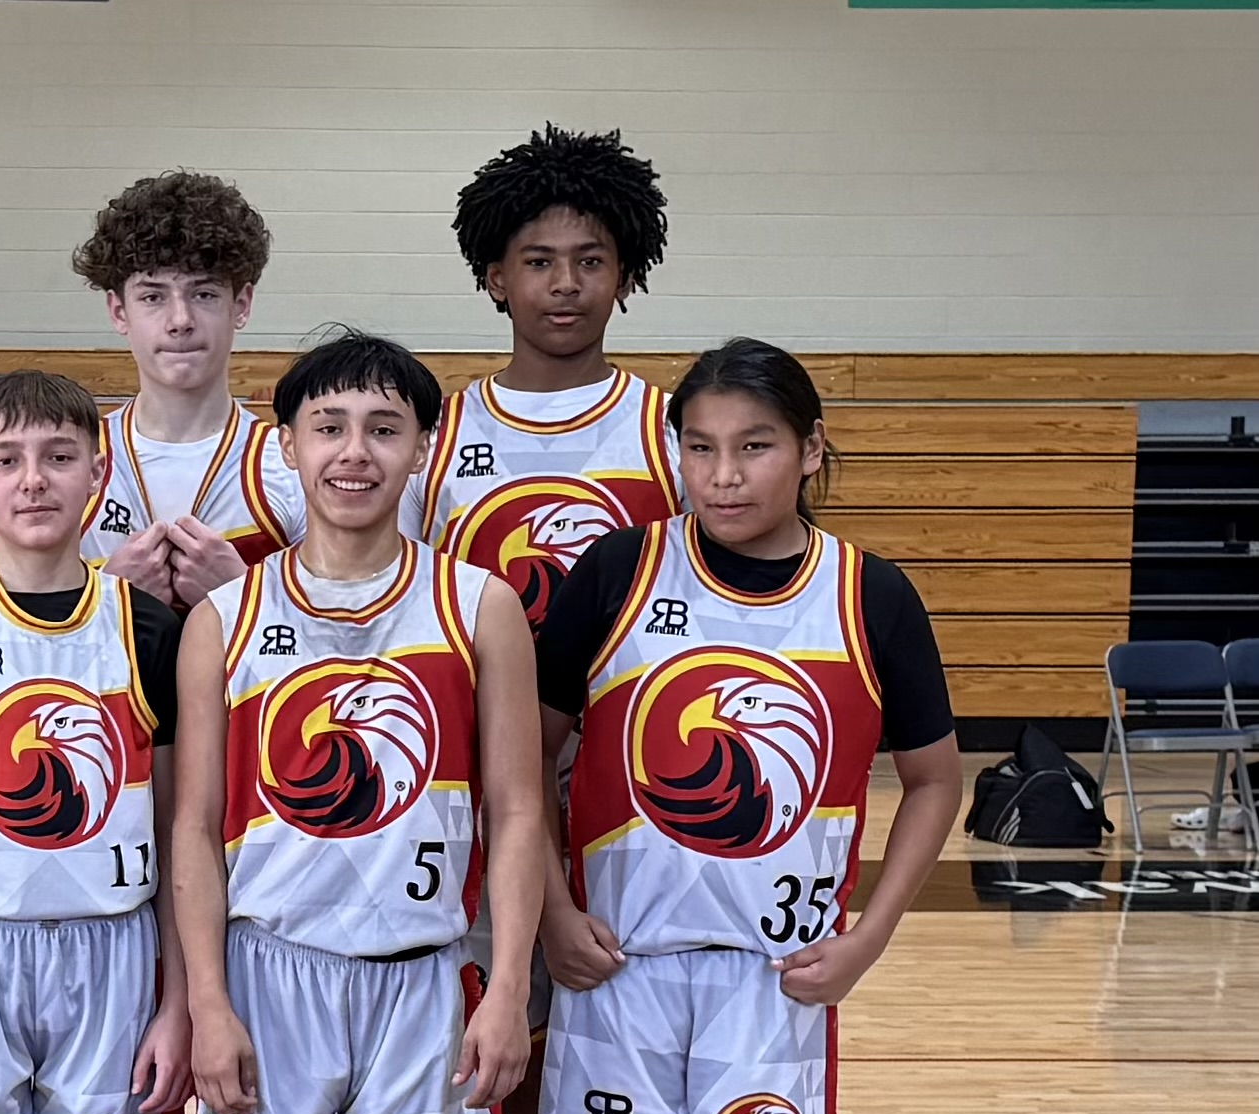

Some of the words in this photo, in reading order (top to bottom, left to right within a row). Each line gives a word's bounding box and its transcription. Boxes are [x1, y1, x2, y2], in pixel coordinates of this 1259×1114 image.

[109, 843, 150, 887] 11
[406, 842, 445, 901] 5
[761, 874, 835, 944] 35
